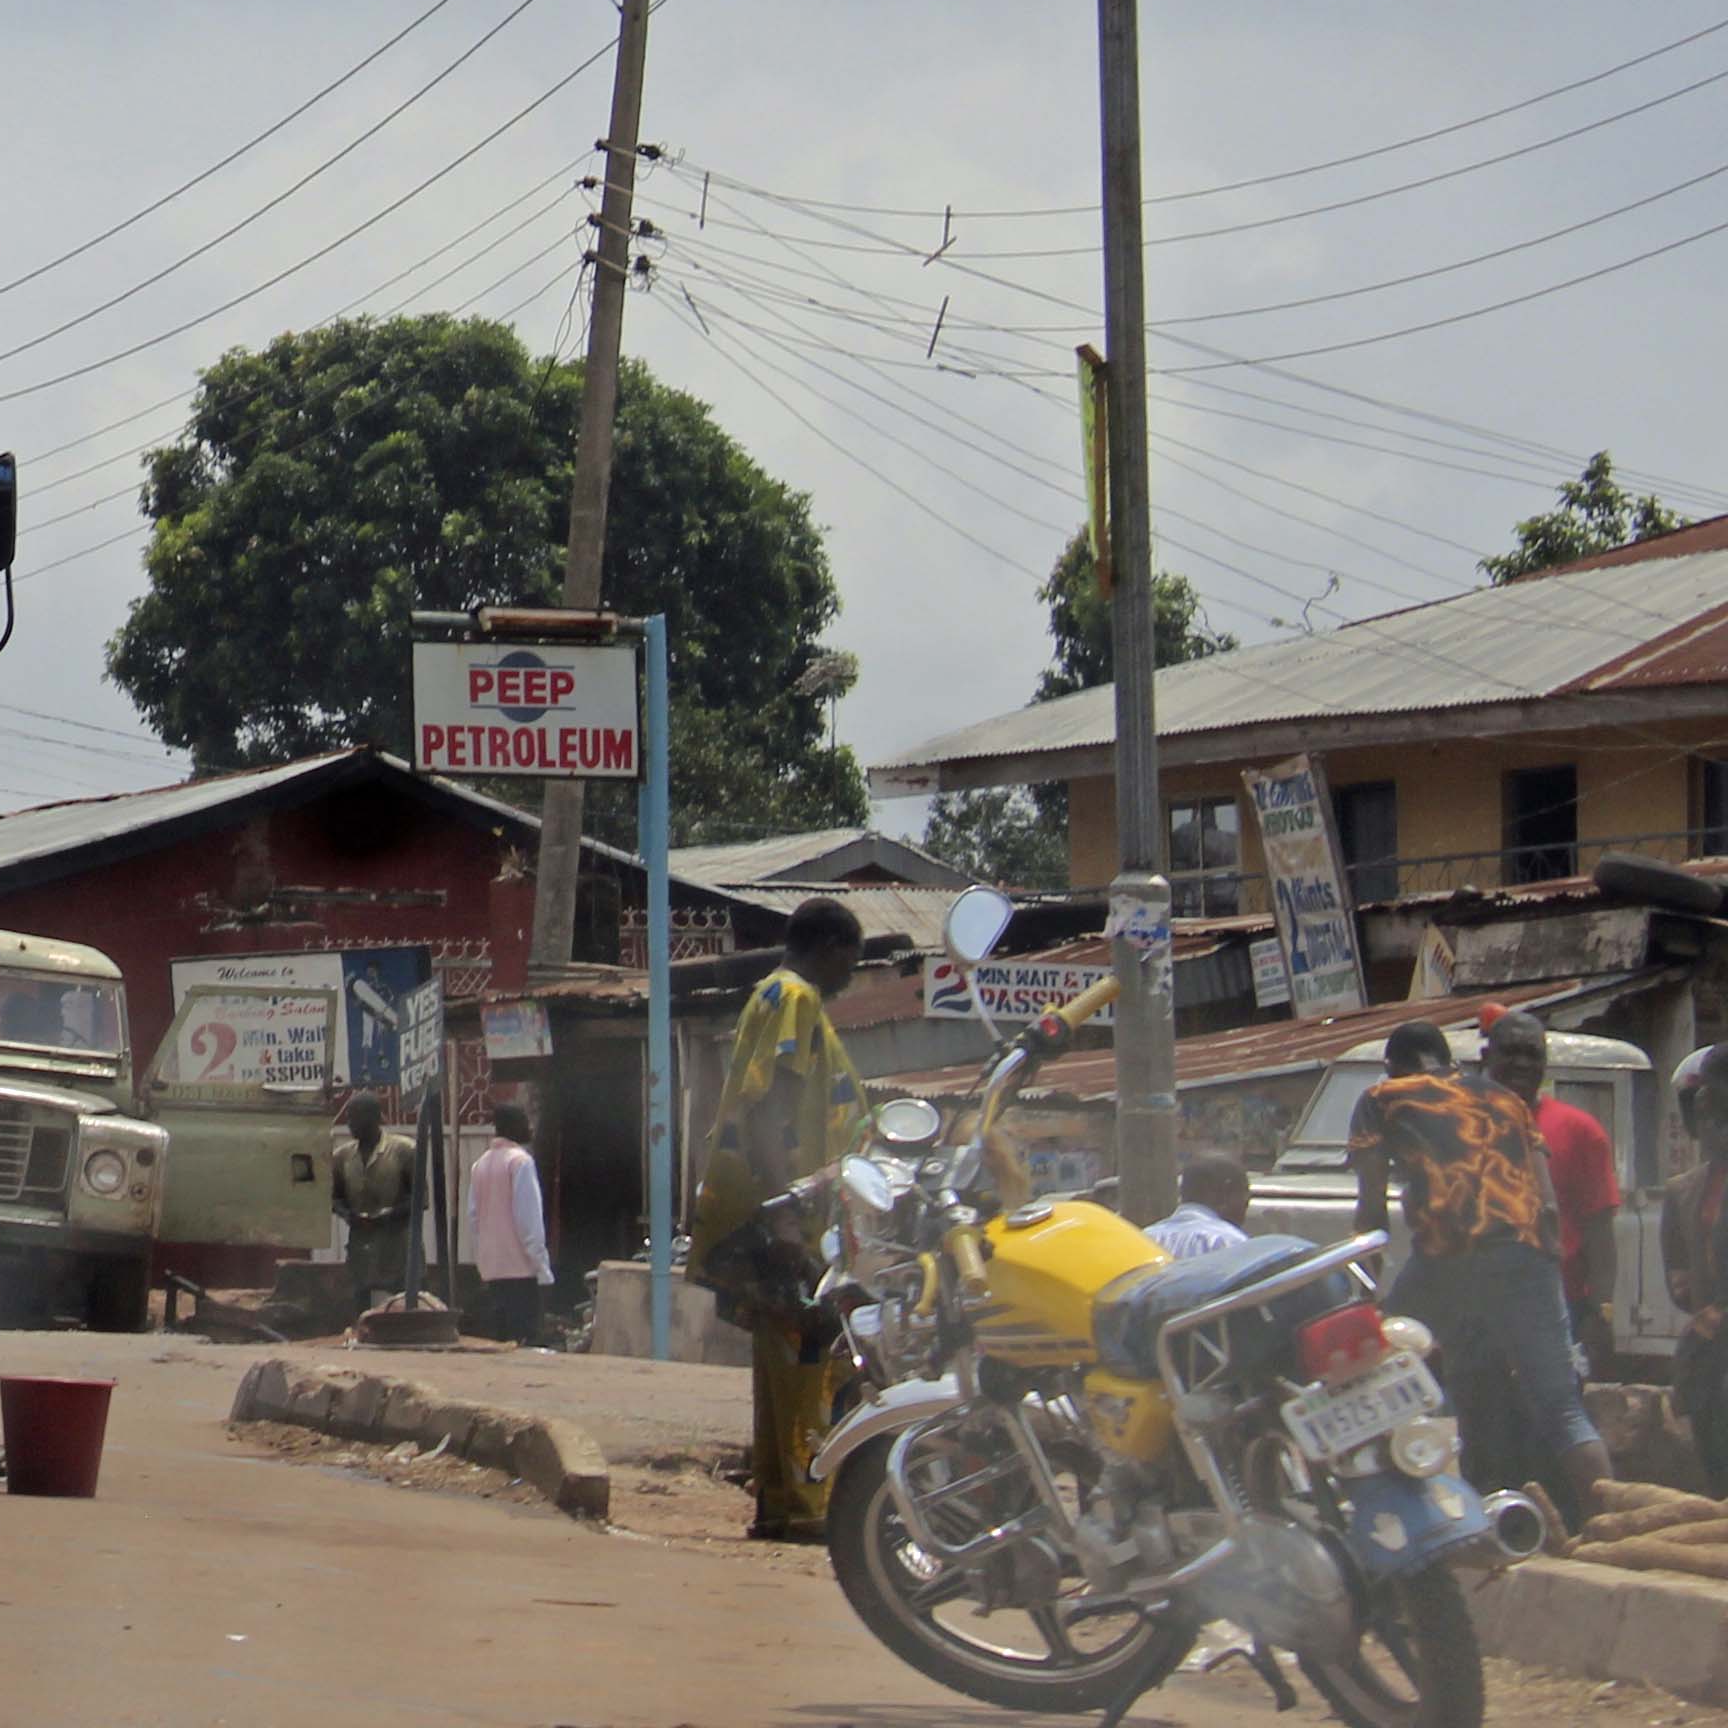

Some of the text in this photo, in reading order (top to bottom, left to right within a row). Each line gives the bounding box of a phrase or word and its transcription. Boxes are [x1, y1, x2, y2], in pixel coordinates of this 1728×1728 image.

[468, 669, 575, 705] PEEP
[422, 725, 633, 770] PETROLEUM
[217, 967, 276, 980] Welcome
[976, 967, 1010, 986] MIN
[1015, 969, 1060, 988] WAIT
[1063, 971, 1078, 988] &
[190, 1022, 237, 1082] 2
[277, 1047, 315, 1064] take
